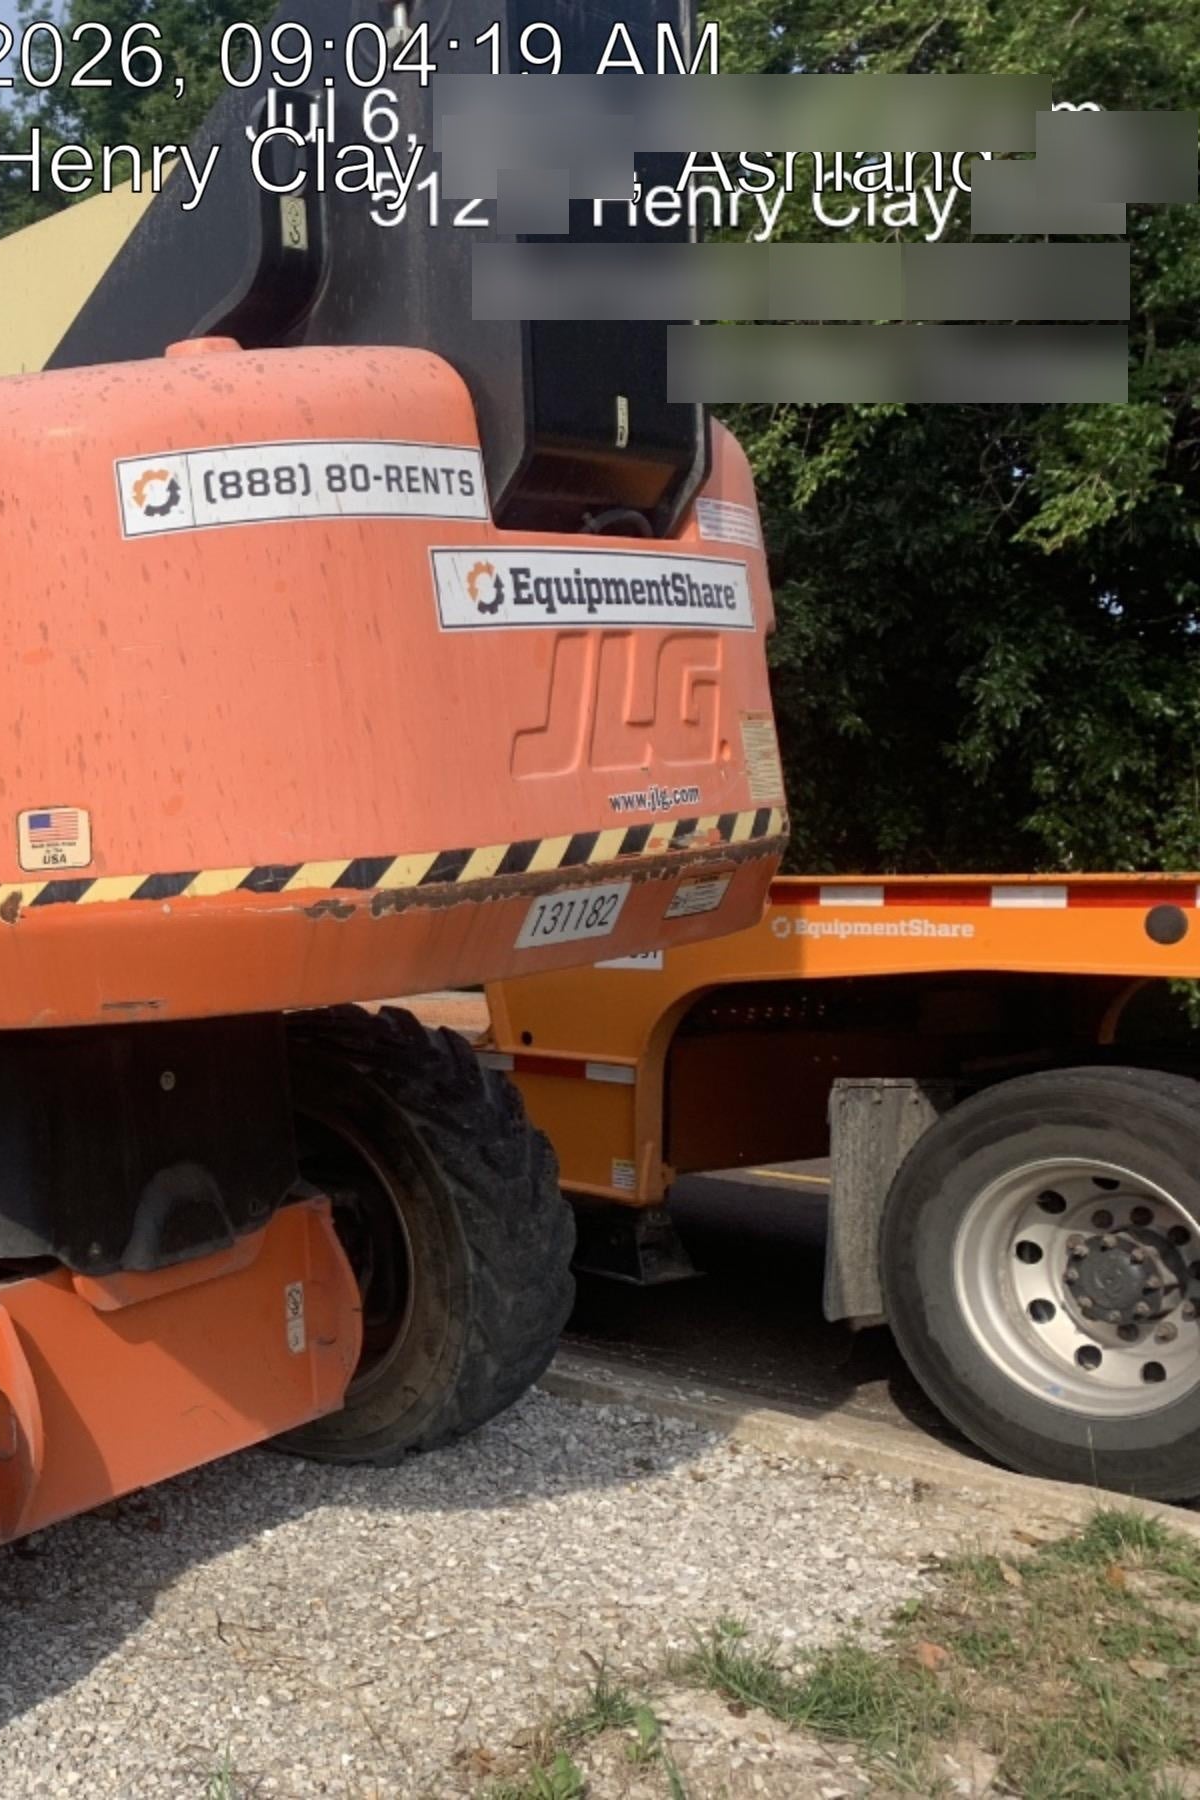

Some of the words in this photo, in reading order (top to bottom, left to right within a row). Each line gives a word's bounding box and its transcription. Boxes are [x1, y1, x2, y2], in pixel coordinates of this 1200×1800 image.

[203, 463, 312, 504] (888)
[325, 463, 476, 497] 80-RENTS
[509, 567, 738, 614] EquipmentShare
[510, 629, 721, 781] JLG
[608, 785, 700, 811] www.jlg.com
[530, 894, 619, 936] 131182
[795, 917, 975, 939] EquipmentShare
